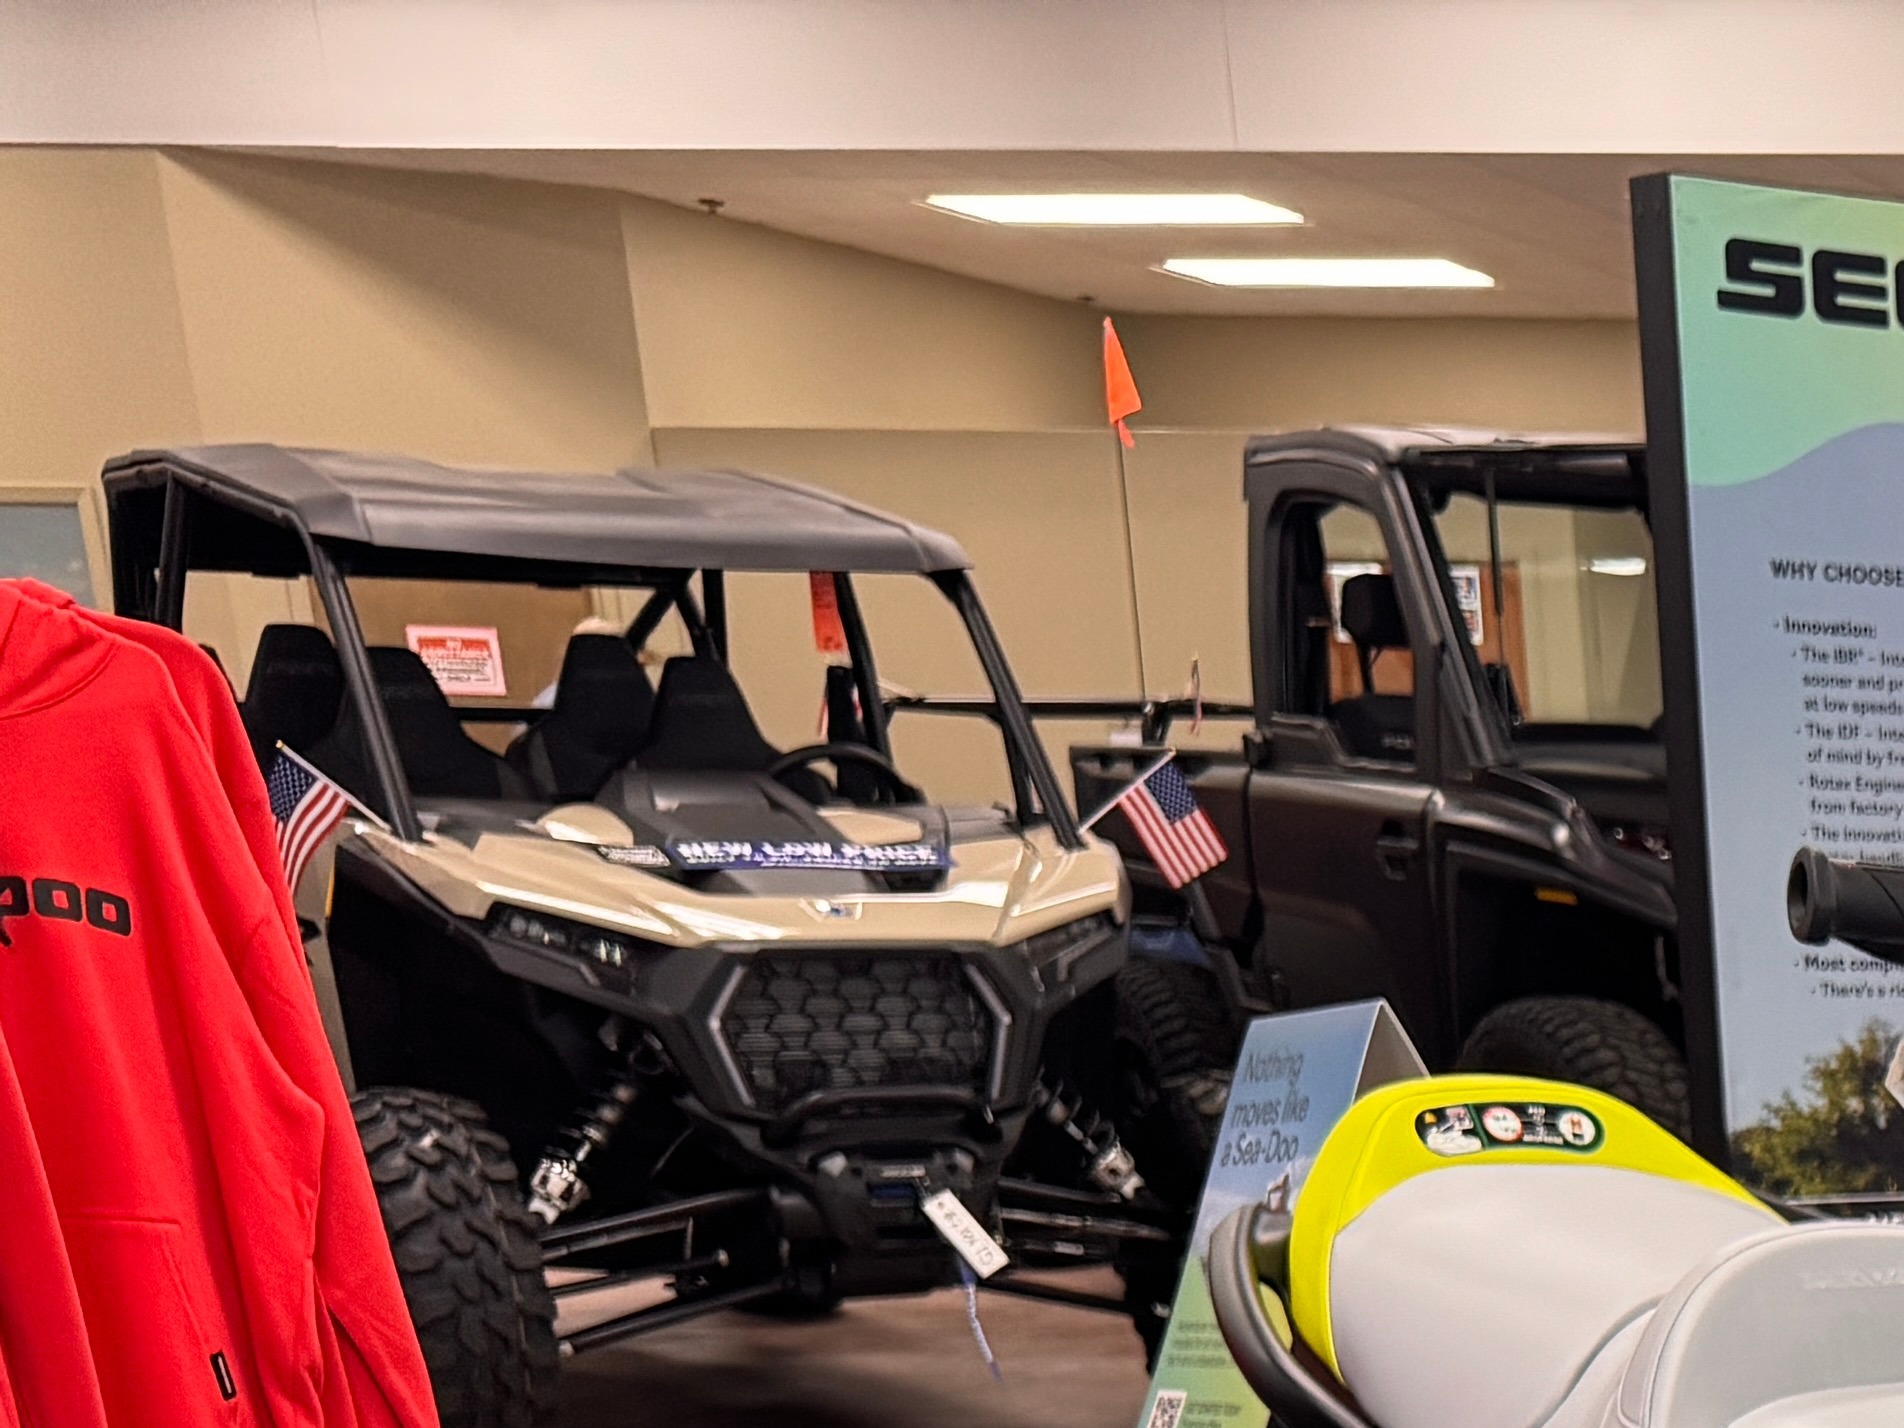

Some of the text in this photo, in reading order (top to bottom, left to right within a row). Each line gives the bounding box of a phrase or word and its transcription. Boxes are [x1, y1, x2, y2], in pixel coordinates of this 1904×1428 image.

[1769, 558, 1817, 582] WHY
[1823, 562, 1904, 587] CHOOSE
[1804, 954, 1847, 972] Most
[1244, 1052, 1304, 1089] Nothing
[1231, 1091, 1310, 1128] moves like
[1232, 1129, 1299, 1167] Sea-Doo
